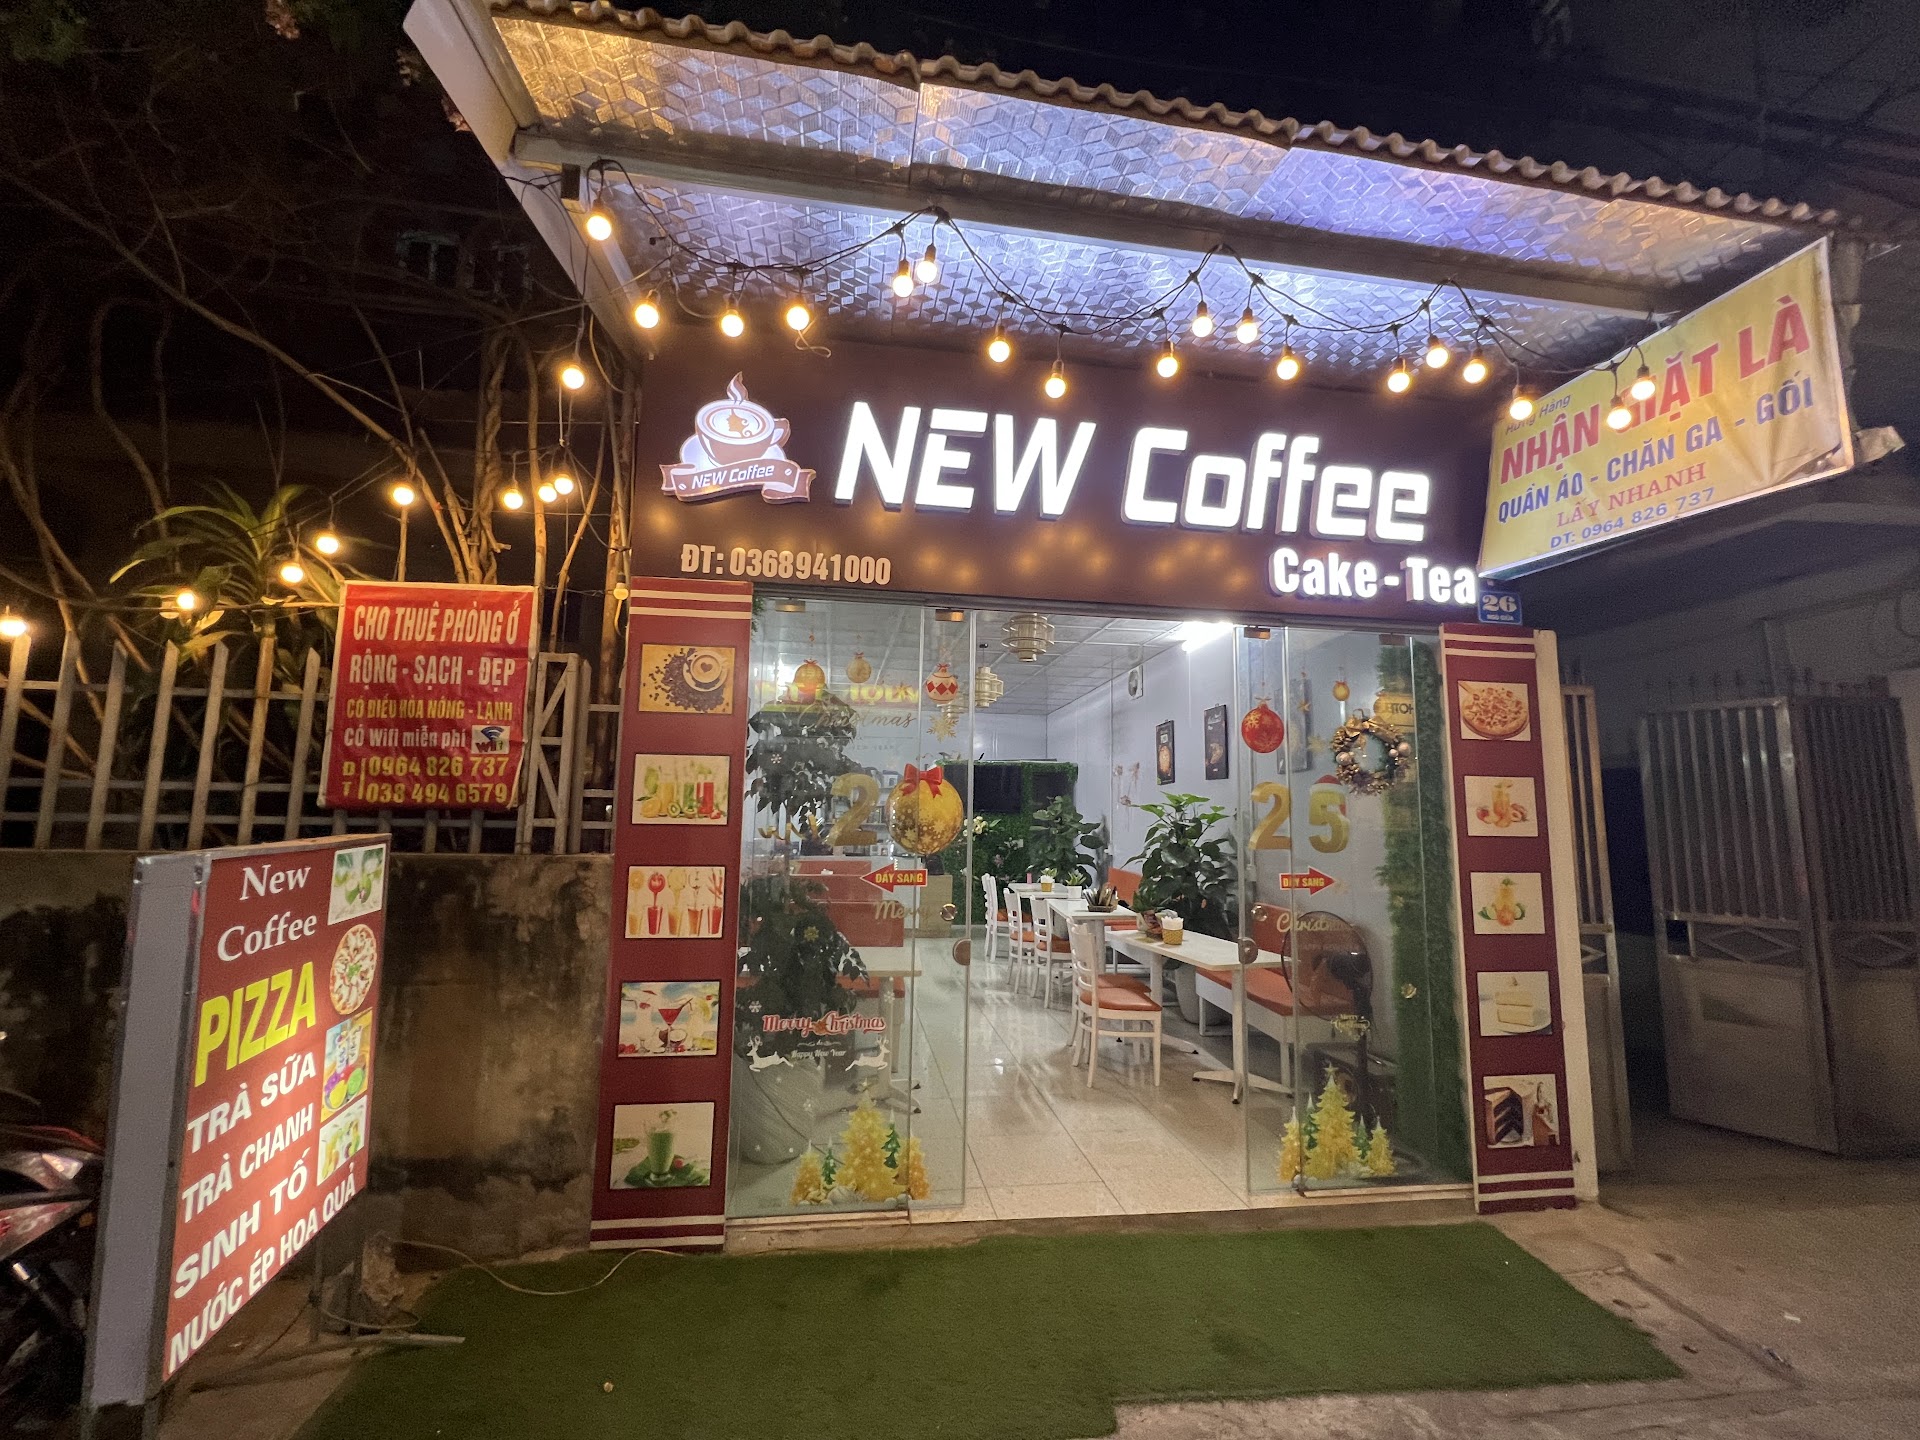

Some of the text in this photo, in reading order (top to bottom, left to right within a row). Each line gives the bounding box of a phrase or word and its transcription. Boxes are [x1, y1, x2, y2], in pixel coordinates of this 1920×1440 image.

[1501, 404, 1600, 484] NHẬN
[1738, 295, 1810, 380] LÀ
[691, 463, 774, 490] NEW Coffee
[834, 401, 1430, 542] NEW Coffee
[1498, 483, 1550, 523] QUẦN
[1555, 472, 1583, 502] ÁO
[1606, 434, 1674, 482] CHĂN
[1685, 416, 1723, 453] GA
[1607, 463, 1706, 511] NHANH
[1582, 517, 1625, 539] 0964
[1631, 503, 1668, 524] 826
[1675, 486, 1715, 511] 737
[681, 543, 891, 586] ĐT: 0368941000
[1269, 547, 1378, 598] Cake
[1401, 556, 1477, 604] Tea
[353, 605, 391, 640] CHO
[393, 600, 440, 642] THUÊ
[1482, 594, 1517, 612] 26
[349, 648, 398, 690] RỘNG
[413, 655, 463, 691] SẠCH
[478, 657, 516, 692] ĐẸP
[477, 701, 513, 724] LẠNH
[369, 727, 399, 747] Wifi
[368, 755, 421, 777] 0964
[426, 755, 464, 777] 826
[469, 757, 509, 777] 737
[366, 783, 406, 803] 038
[411, 783, 449, 803] 494
[455, 783, 508, 804] 6579
[239, 864, 312, 901] New
[896, 872, 923, 883] SANG
[1302, 877, 1325, 887] SANG
[217, 911, 317, 962] Coffee
[194, 961, 317, 1088] PIZZA
[762, 1011, 886, 1038] Merry Christmas
[187, 1051, 316, 1154] TRÀ SỮA
[182, 1102, 314, 1224] TRÀ CHANH
[173, 1147, 311, 1299] SINH TỐ
[248, 1246, 275, 1297] ÉP
[322, 1161, 357, 1222] QUẢ
